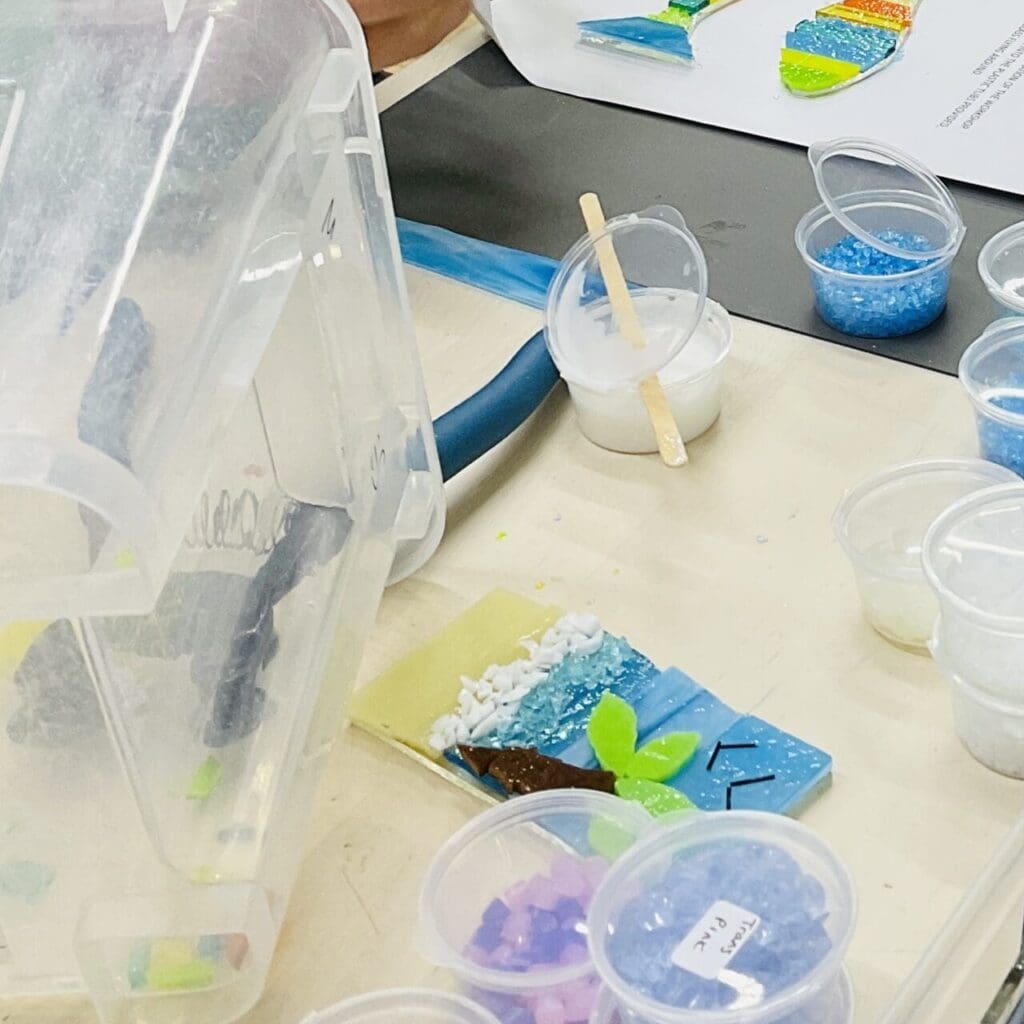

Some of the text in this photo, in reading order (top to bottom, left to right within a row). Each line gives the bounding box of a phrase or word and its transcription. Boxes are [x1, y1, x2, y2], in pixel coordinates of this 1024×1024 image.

[979, 67, 1007, 88] PLASTIC
[965, 87, 987, 102] TUBS
[960, 99, 997, 130] WORKSHOP
